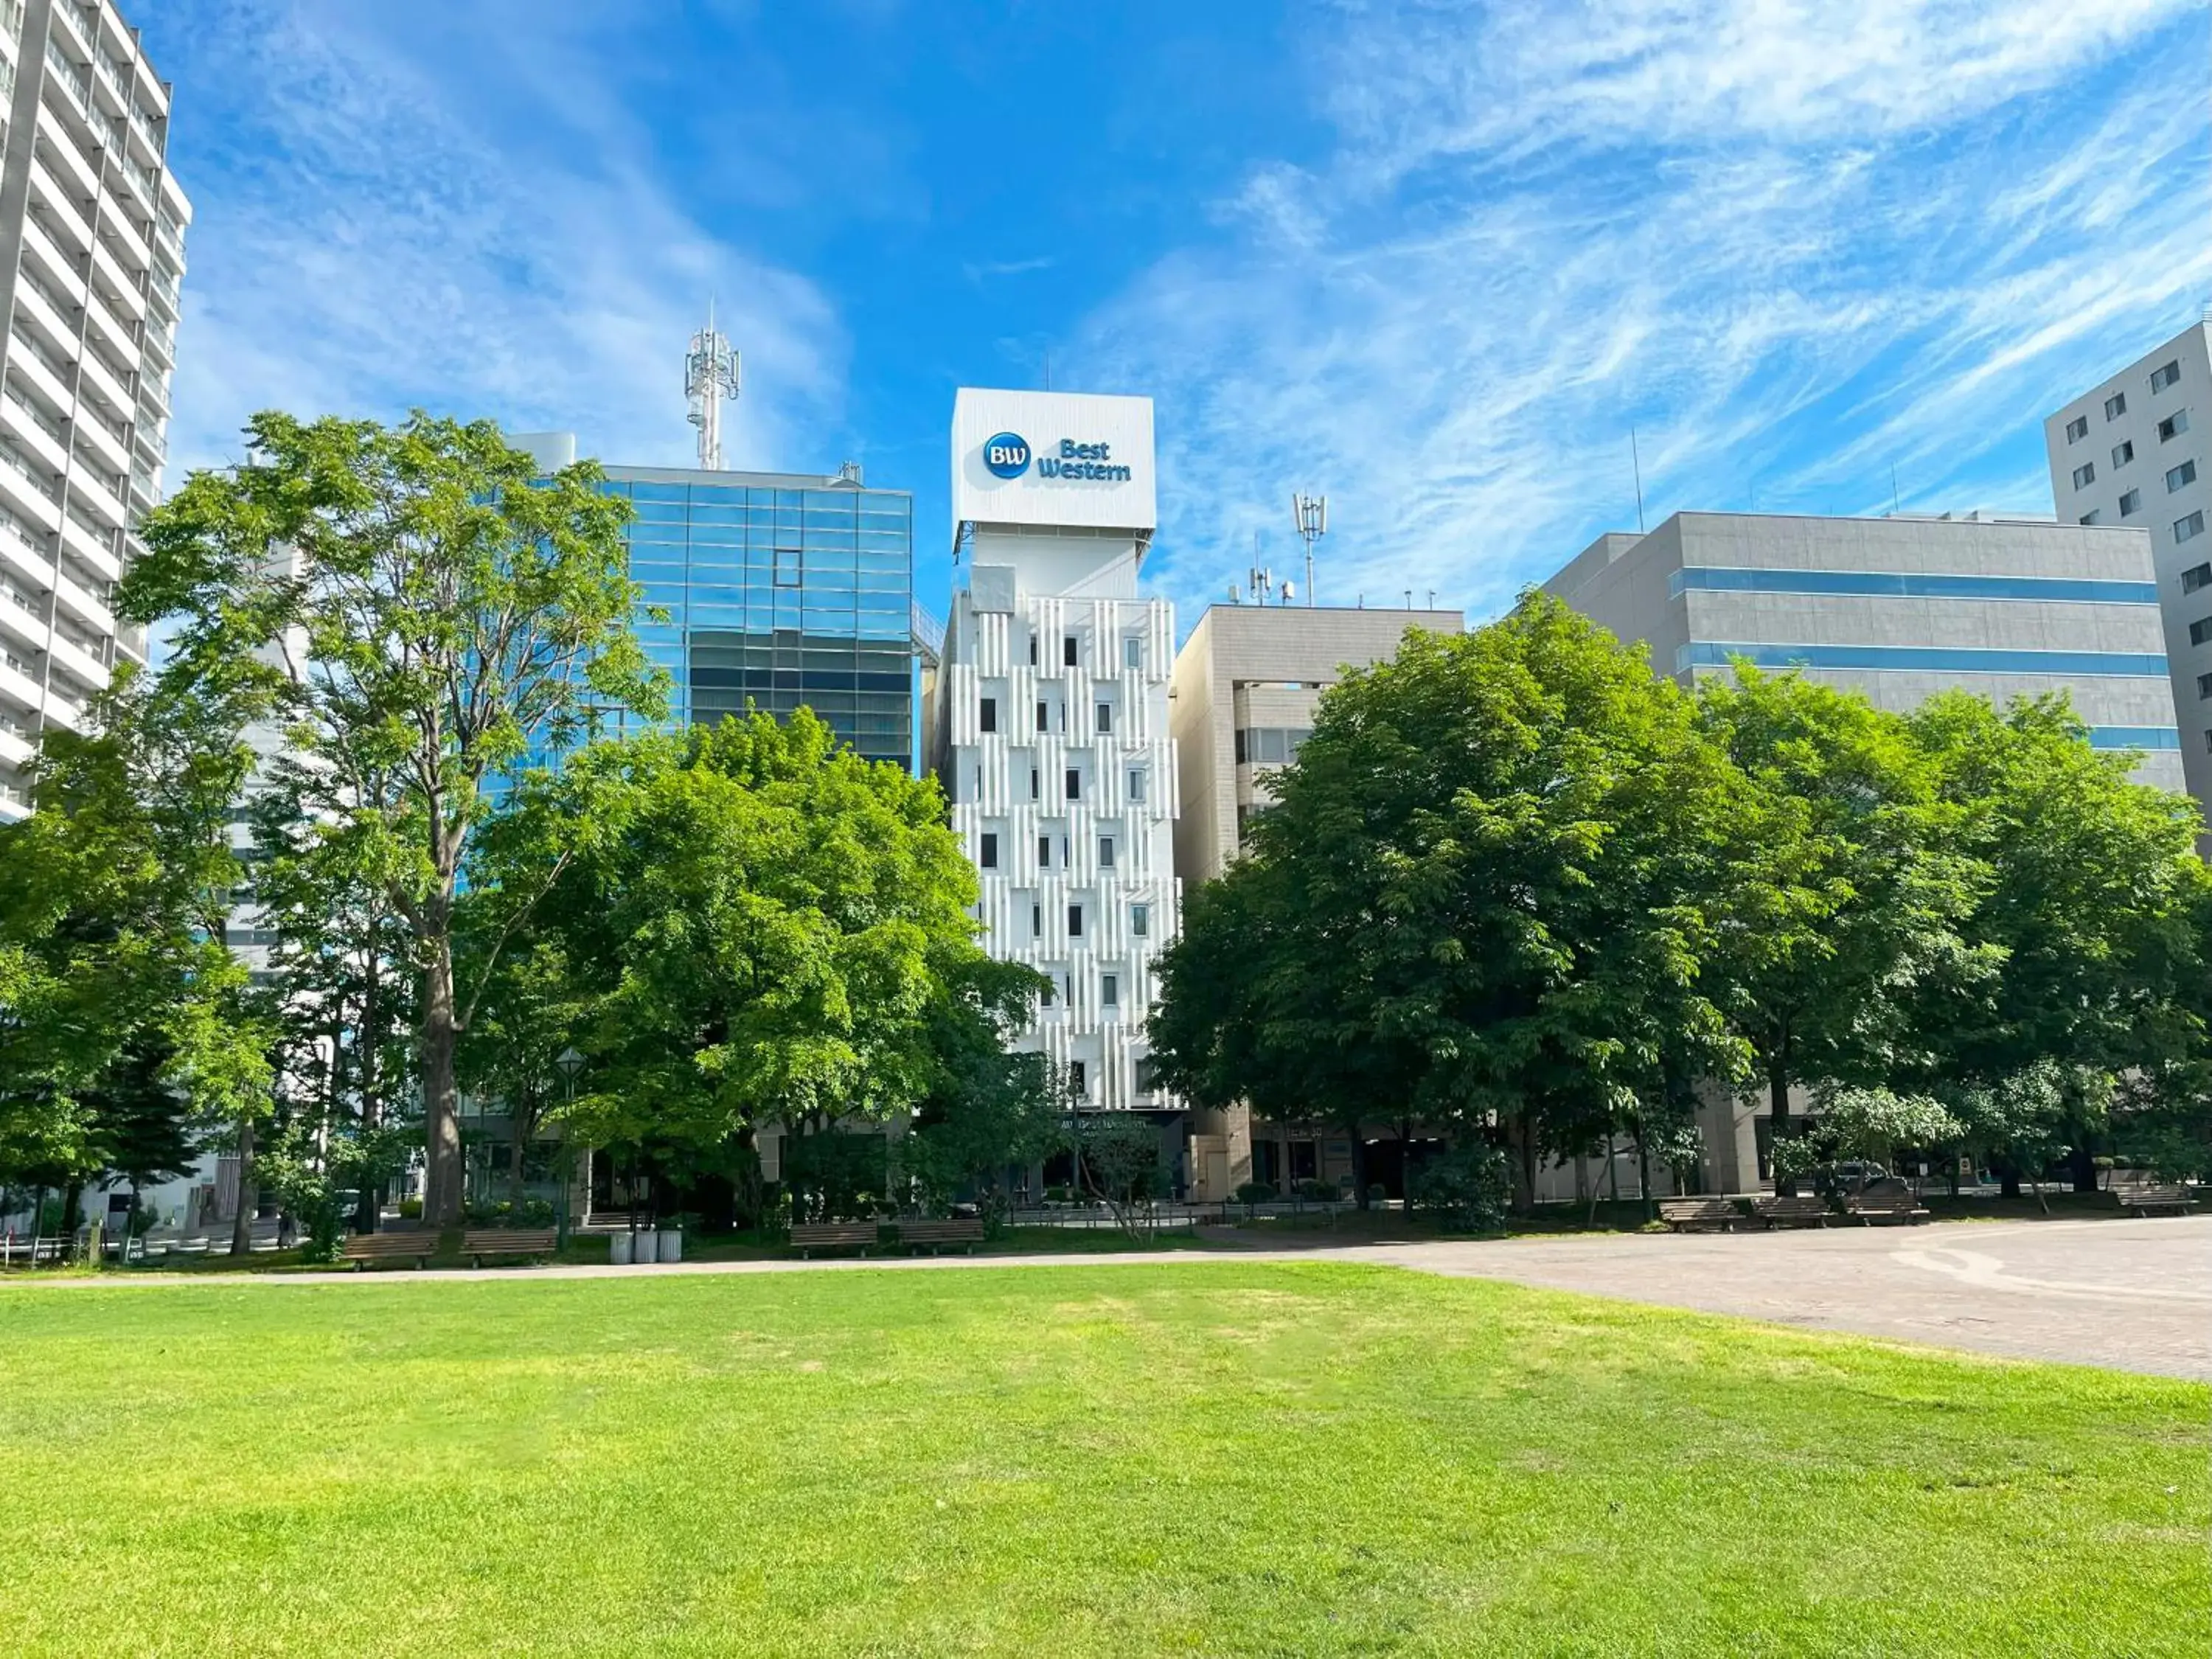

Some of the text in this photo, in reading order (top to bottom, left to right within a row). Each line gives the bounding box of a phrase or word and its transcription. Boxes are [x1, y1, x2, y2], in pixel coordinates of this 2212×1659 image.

[990, 446, 1026, 465] BW
[1060, 438, 1111, 460] Best
[1037, 457, 1132, 481] Western
